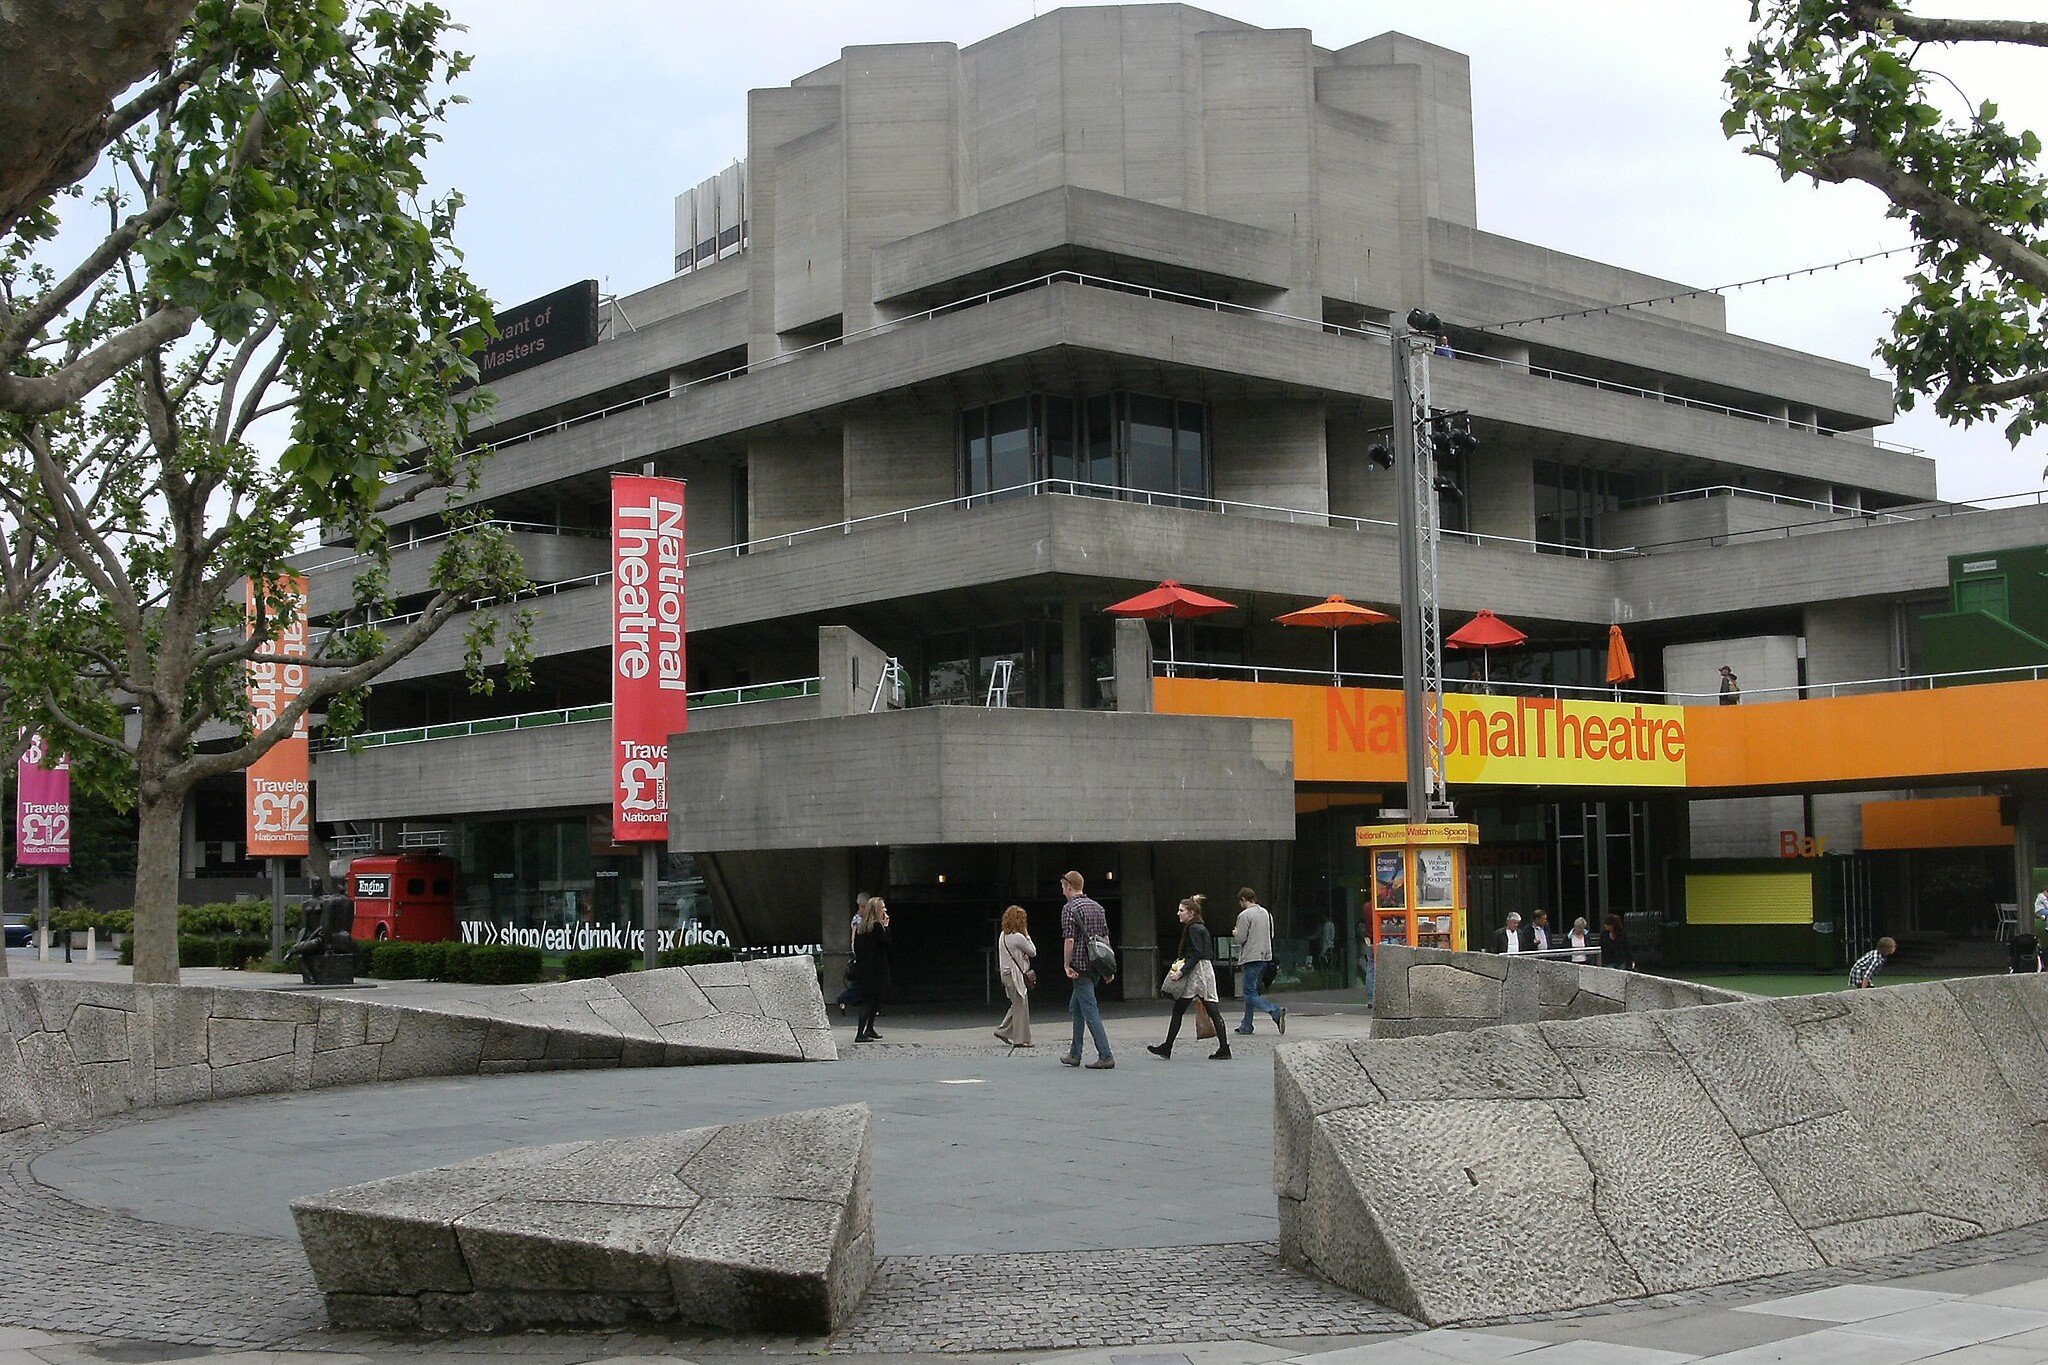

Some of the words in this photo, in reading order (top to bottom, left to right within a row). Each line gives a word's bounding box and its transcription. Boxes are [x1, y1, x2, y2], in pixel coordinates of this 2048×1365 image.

[534, 306, 552, 328] of
[484, 338, 545, 370] Masters
[618, 496, 657, 680] Theatre
[658, 501, 686, 691] National
[620, 740, 668, 759] Trave
[253, 778, 309, 792] Travelex
[620, 759, 669, 810] £1
[22, 802, 70, 814] Travelex
[253, 792, 309, 832] £12
[622, 811, 668, 822] NationalT
[22, 814, 70, 846] £12
[1779, 829, 1830, 858] Bar
[358, 880, 385, 896] Engine
